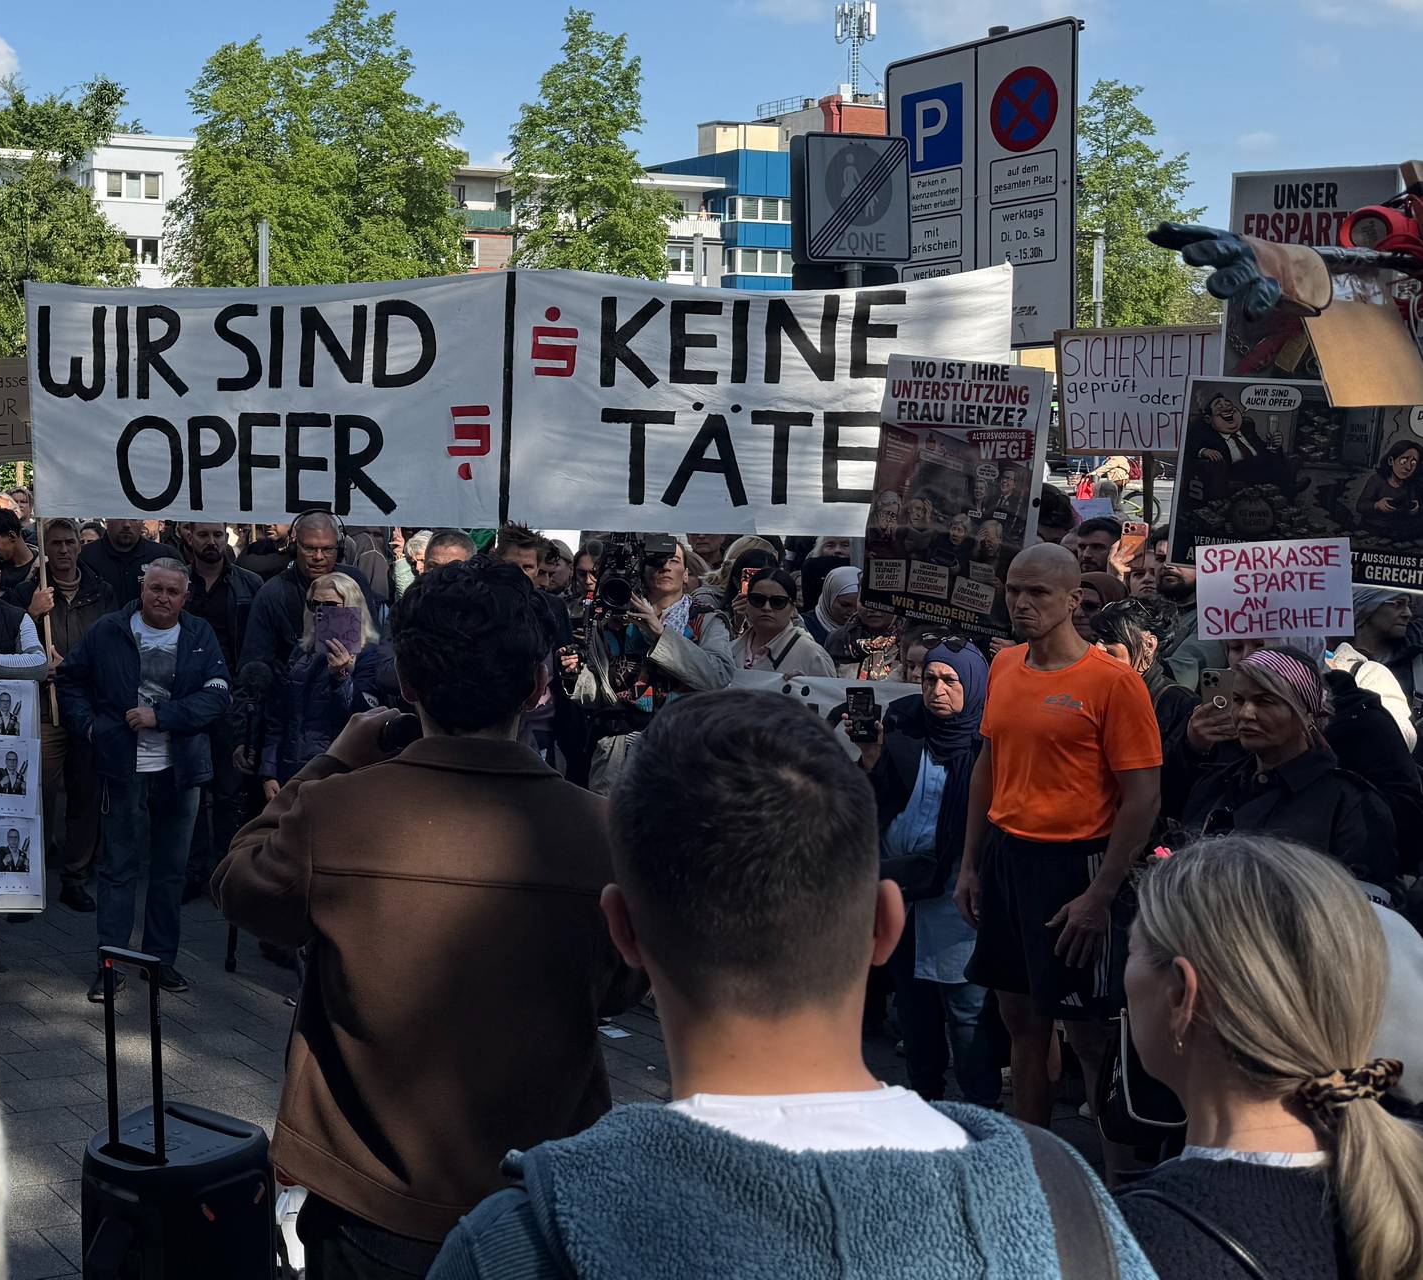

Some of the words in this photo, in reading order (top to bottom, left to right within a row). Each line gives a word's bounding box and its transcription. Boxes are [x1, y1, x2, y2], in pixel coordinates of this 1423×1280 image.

[915, 98, 949, 163] P
[1007, 166, 1020, 176] auf
[1022, 164, 1039, 174] dem
[917, 178, 939, 189] Parken
[941, 176, 947, 184] in
[993, 179, 1031, 194] gesamten
[1033, 175, 1053, 186] Platz
[912, 201, 932, 212] lächen
[934, 197, 956, 209] erlaubt
[1273, 182, 1338, 209] UNSER
[1002, 208, 1044, 222] werktags
[924, 226, 939, 238] mit
[1033, 226, 1045, 237] Sa
[1244, 211, 1351, 246] ERSPART
[835, 232, 886, 252] ZONE
[912, 239, 958, 254] arkschein
[599, 289, 907, 389] KEINE
[37, 304, 190, 401] WIR
[213, 299, 437, 392] SIND
[1063, 333, 1213, 378] SICHERHEIT
[911, 361, 937, 379] WO
[941, 362, 967, 380] IST
[971, 363, 1010, 382] IHRE
[891, 379, 1030, 406] UNTERSTÜTZUNG
[1245, 396, 1267, 406] AUCH
[1268, 397, 1296, 407] OPFER!
[1254, 387, 1270, 397] WIR
[1272, 388, 1289, 398] SIND
[897, 401, 945, 423] FRAU
[951, 404, 1028, 428] HENZE?
[972, 431, 1027, 441] ALTERSVORSORGE
[1070, 411, 1183, 449] BEHAUPT
[601, 401, 881, 508] TÄTE
[978, 439, 1027, 460] WEG!
[115, 412, 398, 516] OPFER
[1201, 545, 1342, 575] SPARKASSE
[1361, 552, 1418, 567] AUSSCHLUSS
[1233, 570, 1327, 594] SPARTE
[891, 594, 915, 610] WIR
[919, 601, 979, 623] FORDERN:
[1241, 596, 1268, 612] AN
[1204, 606, 1352, 636] SICHERHEIT
